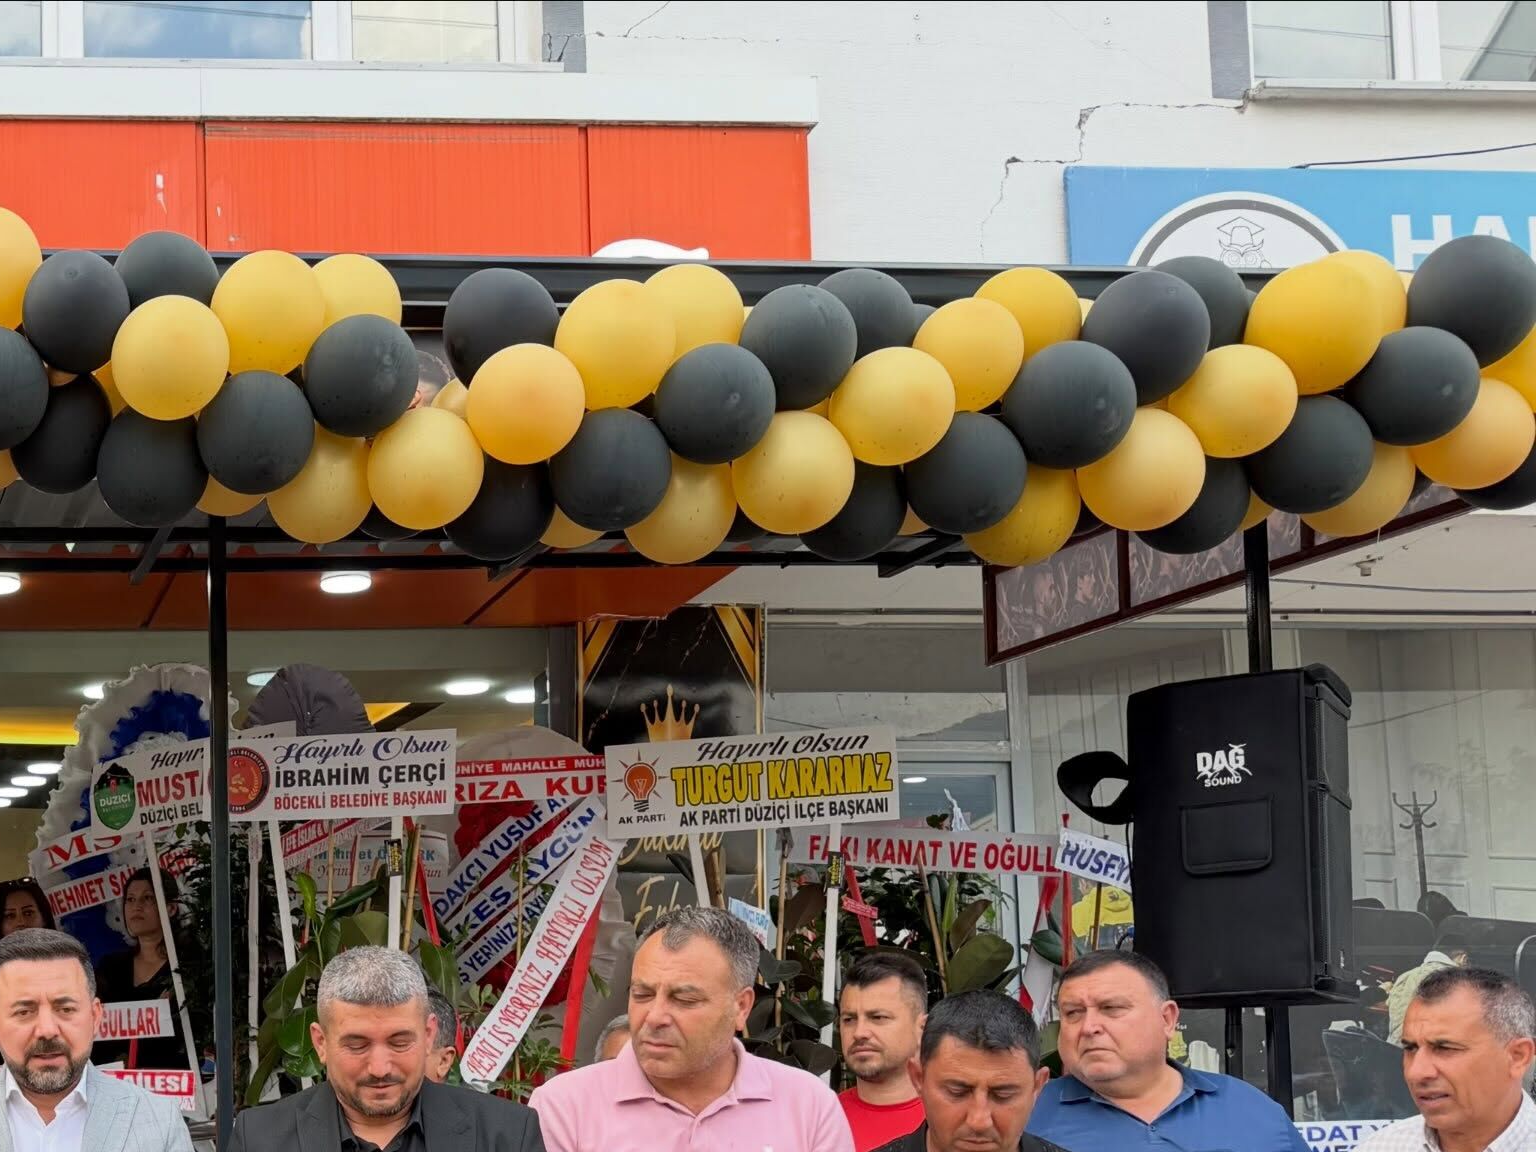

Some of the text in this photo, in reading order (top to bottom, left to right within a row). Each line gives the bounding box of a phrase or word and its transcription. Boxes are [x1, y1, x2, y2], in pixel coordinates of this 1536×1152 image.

[150, 746, 204, 771] Hayır
[272, 737, 367, 765] Hayırlı
[371, 734, 452, 762] Olsun
[696, 733, 870, 763] Hayırlı Olsun
[1196, 743, 1247, 773] DAĞ
[274, 762, 370, 789] İBRAHİM
[378, 758, 446, 789] ÇERÇİ
[501, 758, 567, 774] MAHALLE
[574, 755, 605, 770] MUH
[670, 752, 893, 807] TURGUT KARARMAZ
[136, 770, 204, 808] MUST
[1204, 775, 1242, 787] SOUND
[140, 806, 179, 827] DÜZİÇİ
[181, 804, 203, 819] BEL
[273, 789, 448, 811] BÖCEKLİ BELEDİYE BAŞKANI
[679, 796, 889, 828] AK PARTİ DÜZİÇİ İLÇE BAŞKANI
[482, 804, 545, 861] YUSUF
[618, 815, 634, 825] AK
[866, 837, 942, 868] KANAT
[949, 840, 977, 869] VE
[983, 836, 1060, 873] OĞULL
[1060, 838, 1131, 884] HÜSEY
[535, 894, 589, 967] HAYIRLI
[570, 834, 615, 897] OLSUN
[466, 921, 518, 974] YERİNİZ
[124, 1070, 190, 1093] AİLESİ
